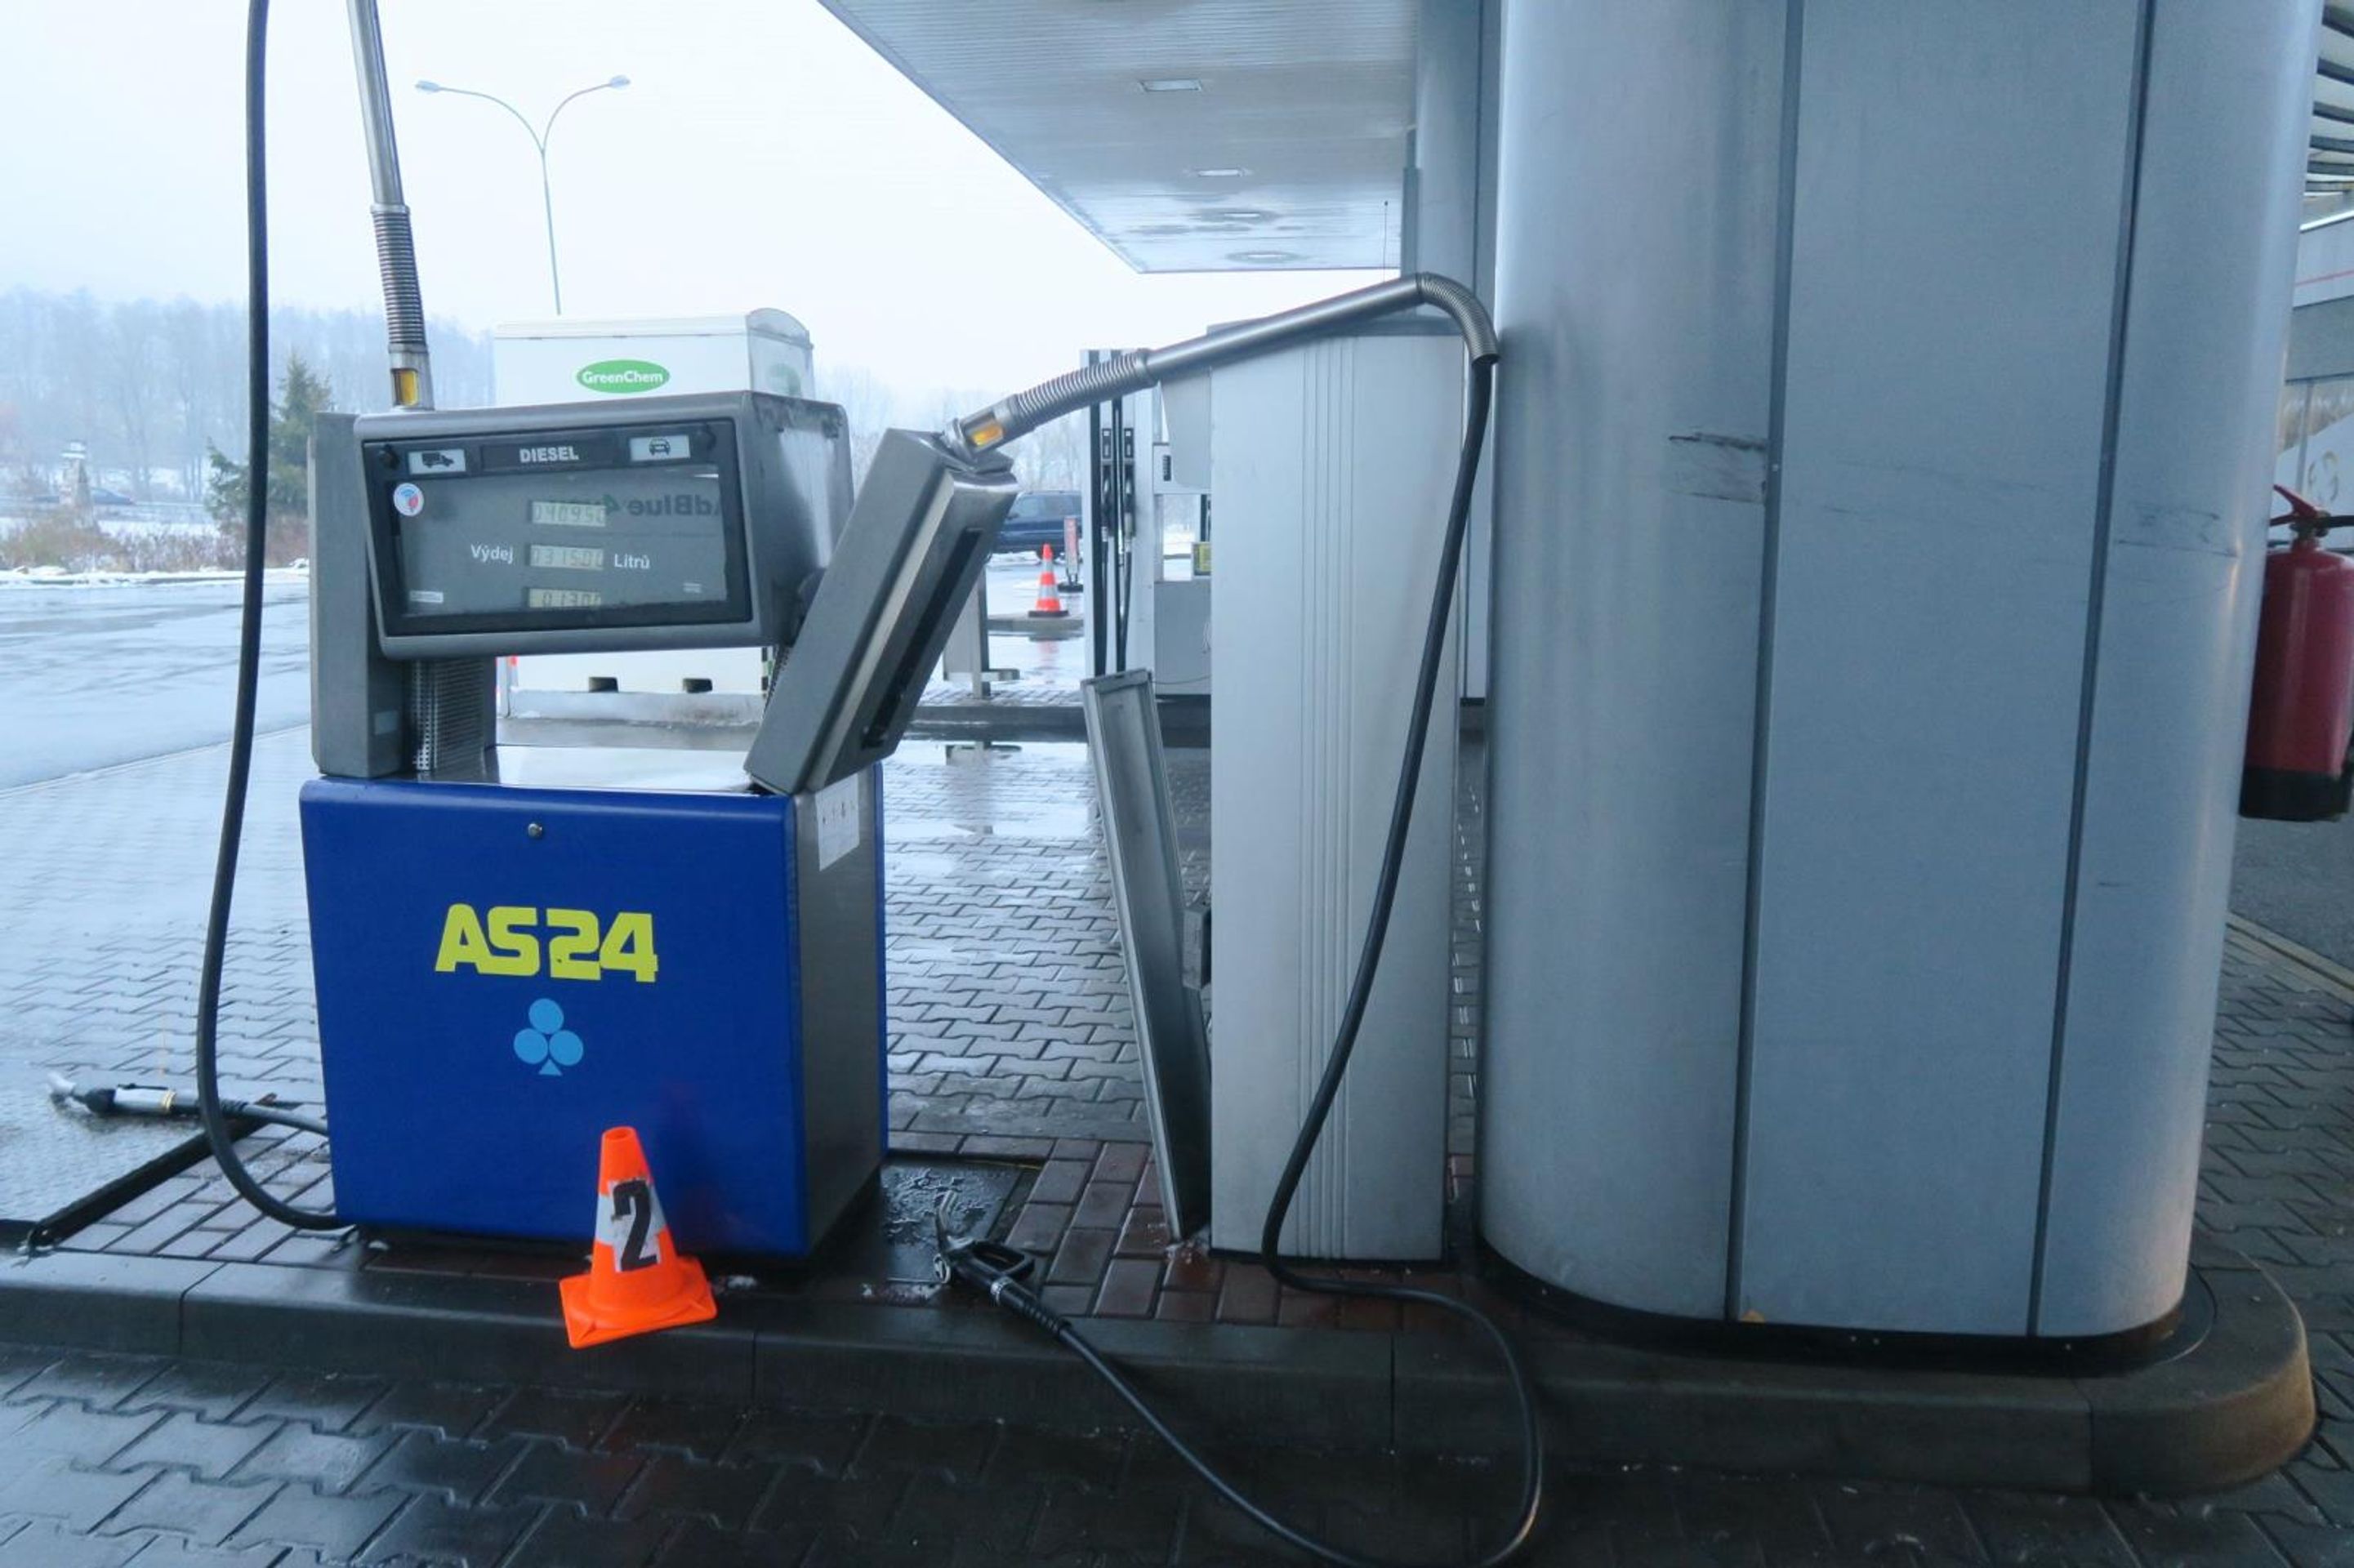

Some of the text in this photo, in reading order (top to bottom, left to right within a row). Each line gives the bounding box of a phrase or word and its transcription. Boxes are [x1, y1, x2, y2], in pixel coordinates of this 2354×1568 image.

[582, 370, 663, 384] GreenChem
[519, 446, 579, 463] DIESEL
[470, 542, 513, 564] Výdej
[614, 553, 650, 569] Litrů
[435, 902, 658, 982] AS24
[612, 1178, 657, 1272] 2
